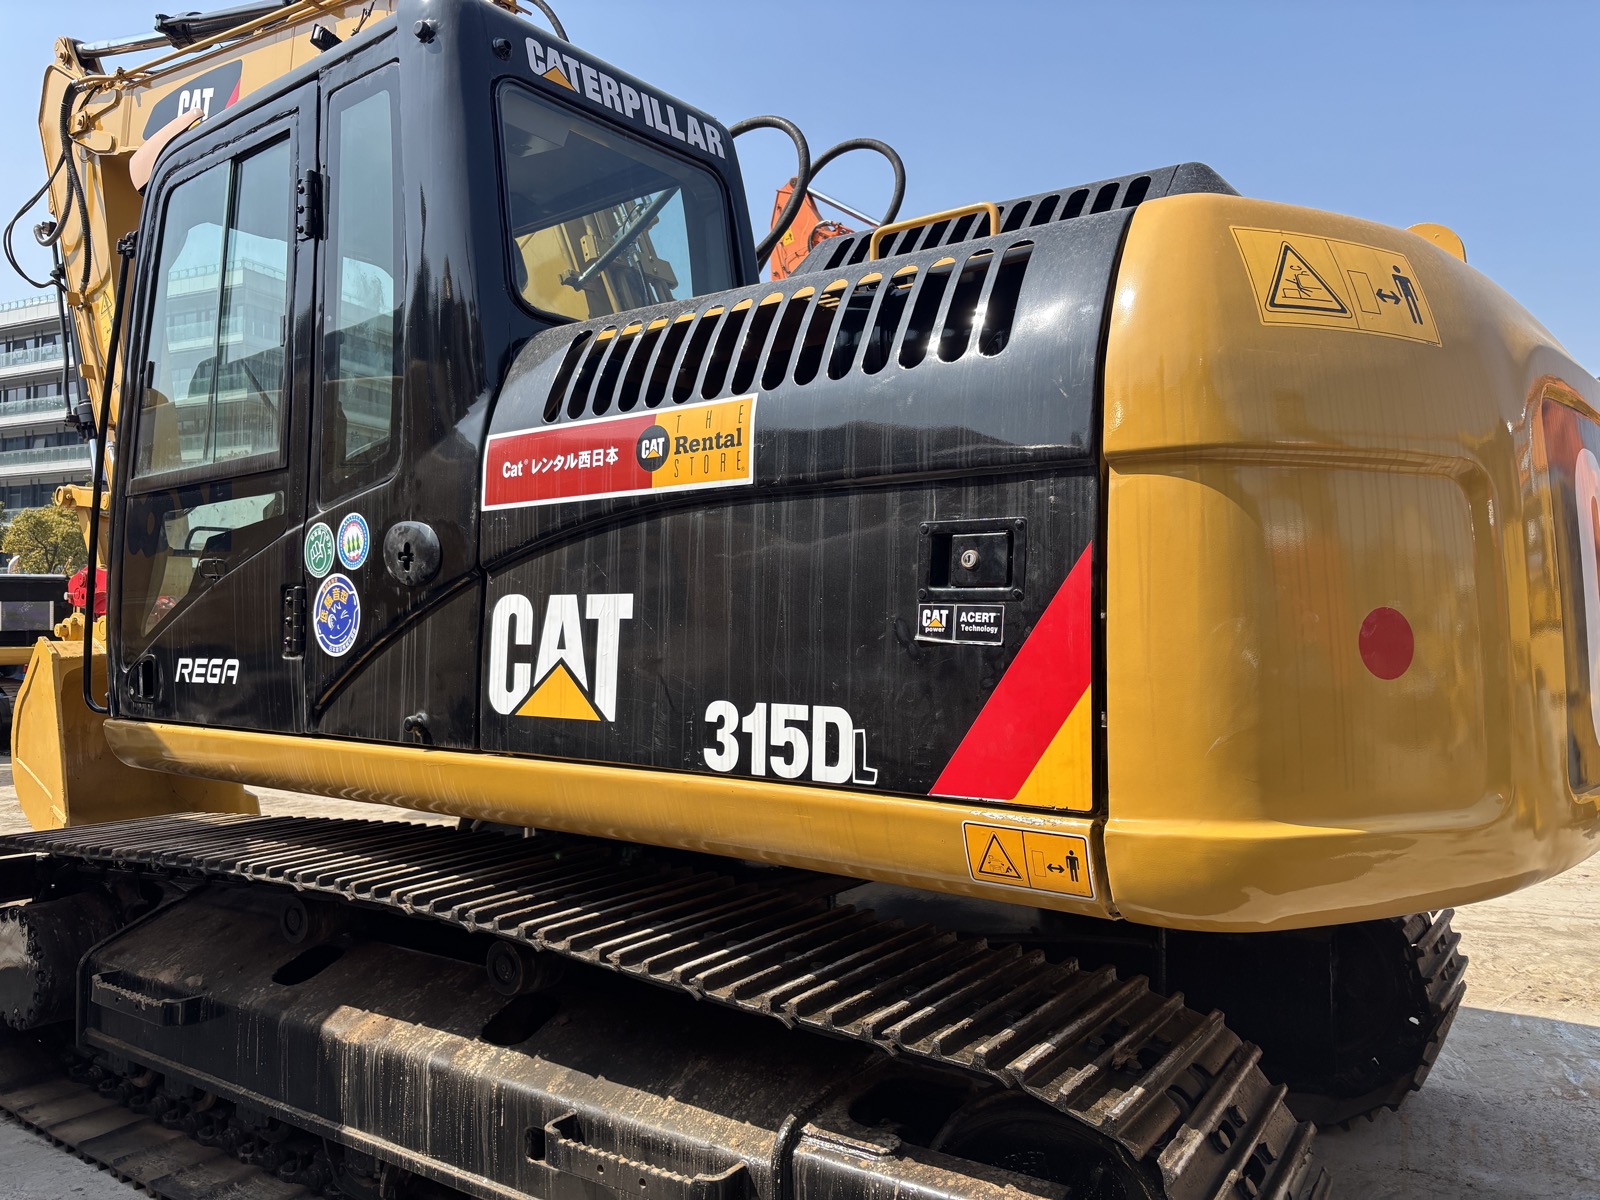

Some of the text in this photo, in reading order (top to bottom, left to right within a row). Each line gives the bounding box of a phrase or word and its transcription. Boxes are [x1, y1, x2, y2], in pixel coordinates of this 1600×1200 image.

[177, 87, 214, 121] CAT
[525, 36, 726, 160] CATERPILLAR
[676, 404, 744, 433] THE
[641, 437, 665, 460] CAT
[673, 428, 743, 456] Rental
[531, 446, 619, 476] レンタル西日本
[922, 609, 949, 627] CAT
[960, 624, 998, 634] Technology
[174, 657, 240, 685] REGA
[489, 593, 634, 723] CAT
